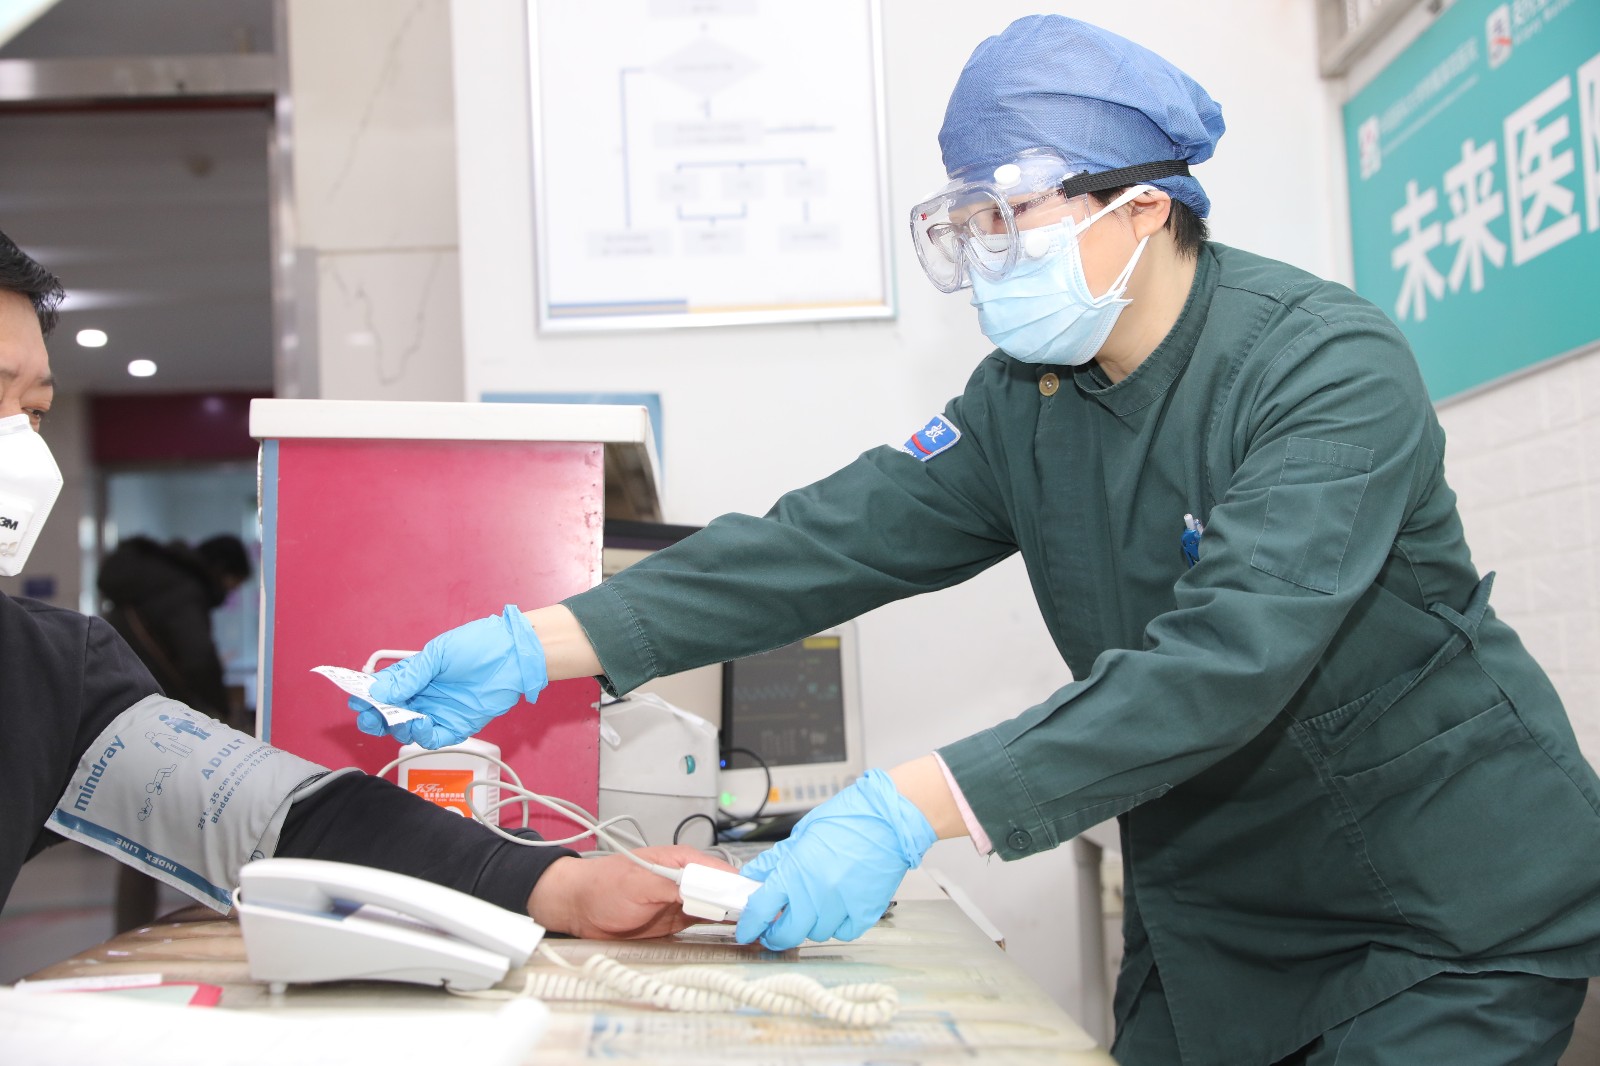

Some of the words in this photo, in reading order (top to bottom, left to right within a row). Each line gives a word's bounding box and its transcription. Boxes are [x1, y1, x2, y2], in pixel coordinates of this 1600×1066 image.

[1391, 52, 1600, 323] 未来医
[0, 516, 19, 530] 3M
[74, 735, 125, 811] mindray
[201, 738, 246, 780] ADULT
[197, 817, 206, 830] 25
[209, 791, 220, 805] 35
[218, 777, 230, 792] cm
[229, 762, 245, 777] arm
[210, 786, 235, 824] Bladder
[114, 838, 140, 854] LINE
[144, 852, 178, 873] INDEX
